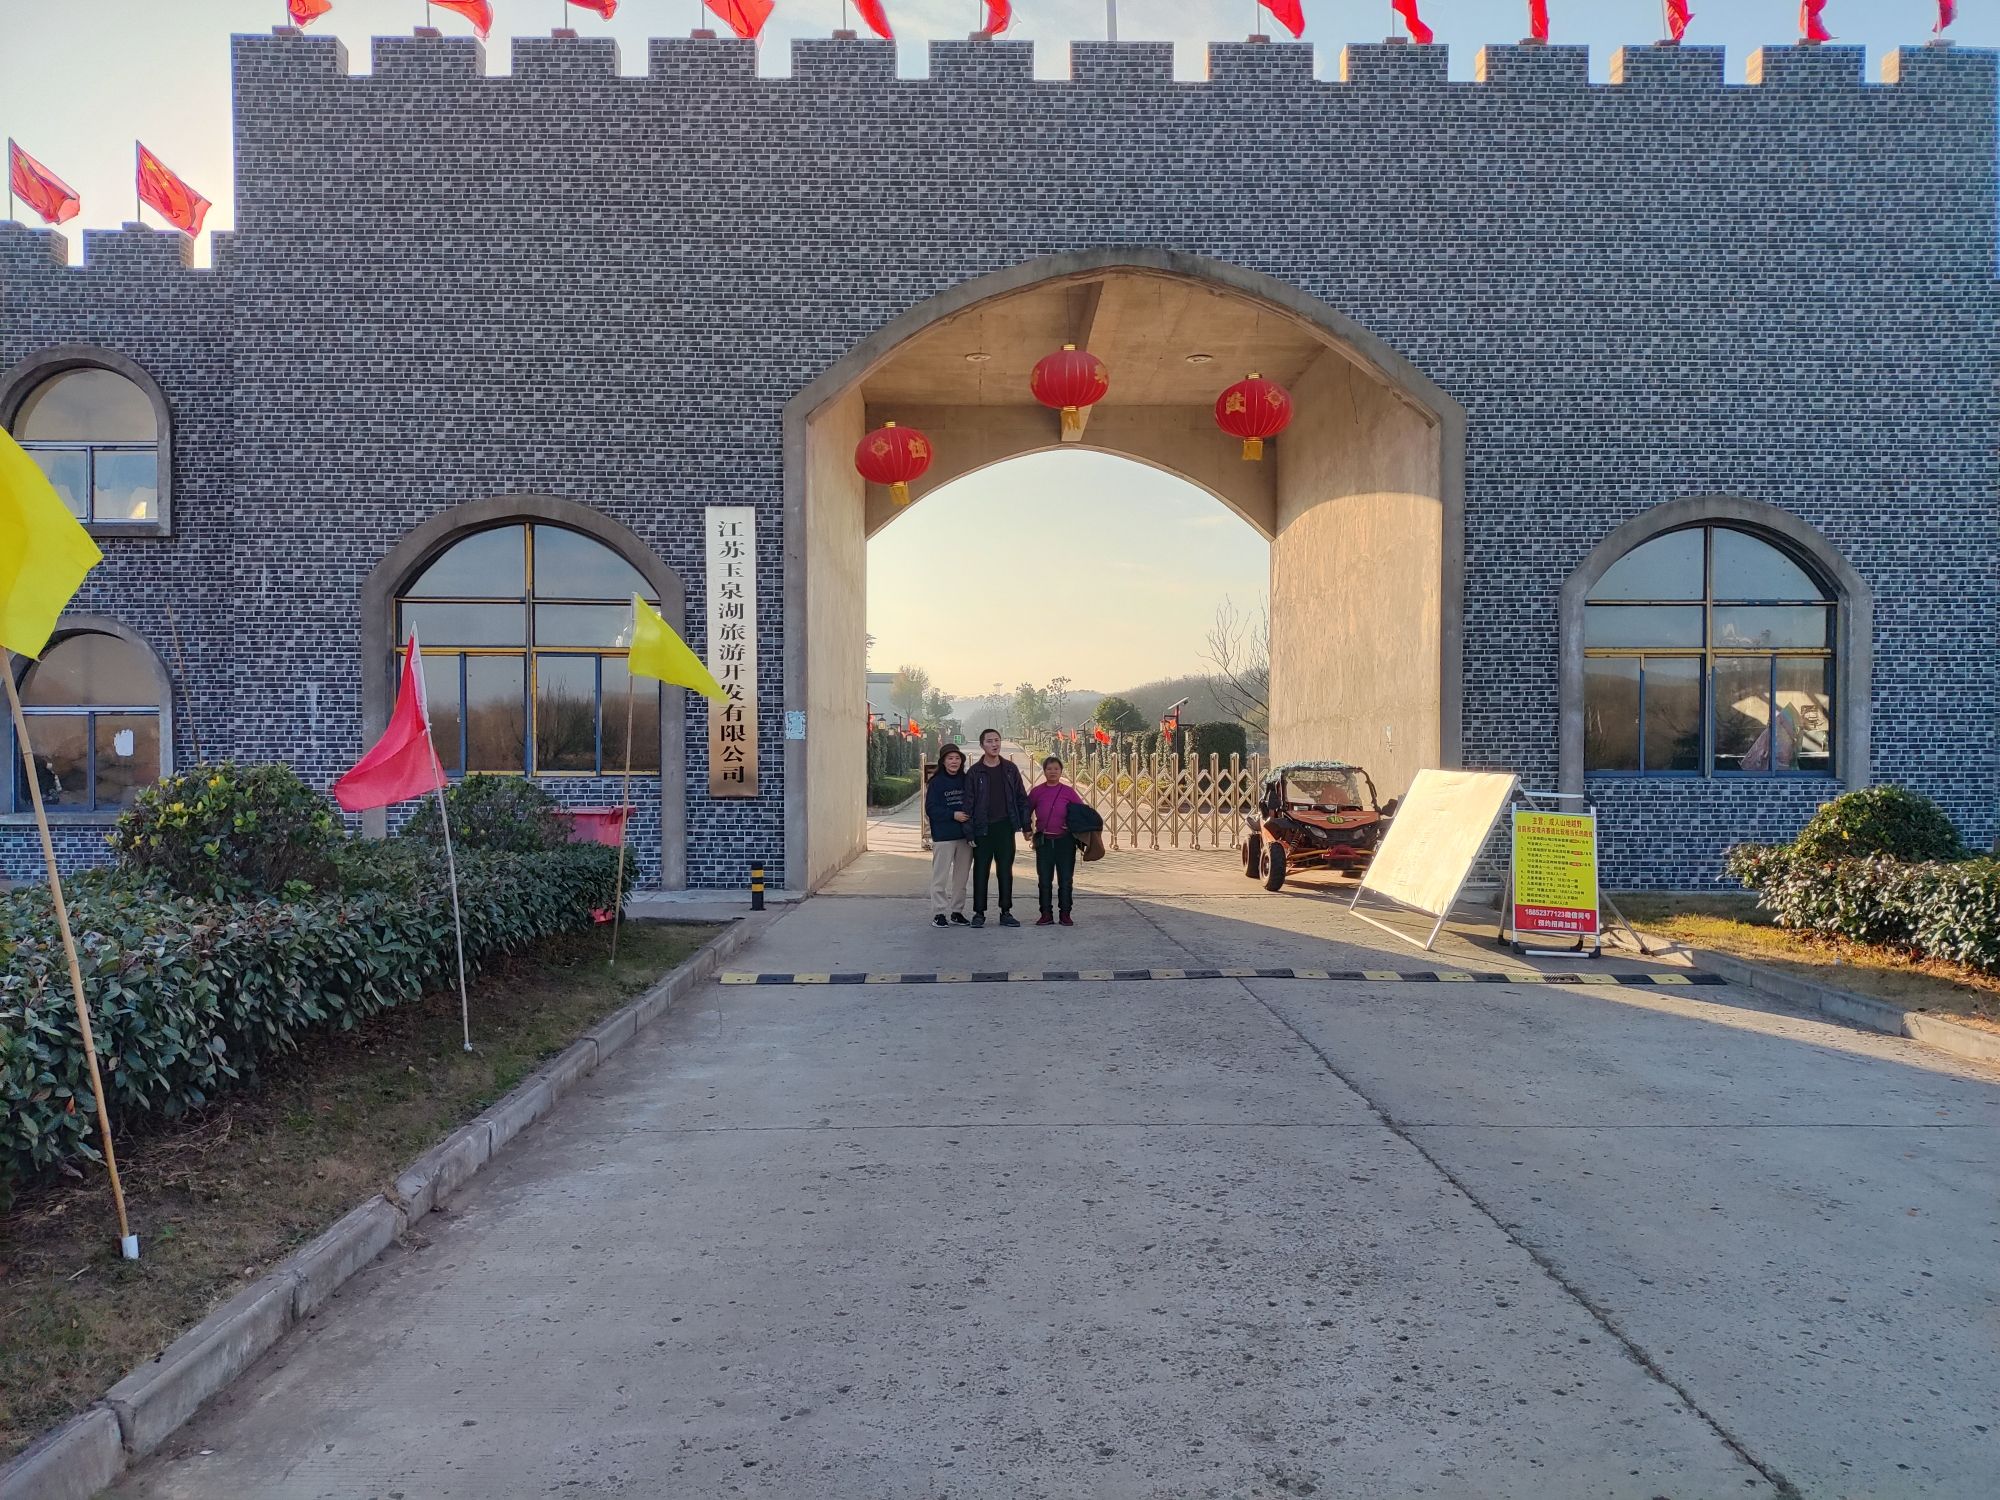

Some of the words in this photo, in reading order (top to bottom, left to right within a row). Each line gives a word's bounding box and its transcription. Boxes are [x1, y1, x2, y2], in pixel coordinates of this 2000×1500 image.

[718, 520, 747, 784] 江苏玉泉湖旅游开发有限公司
